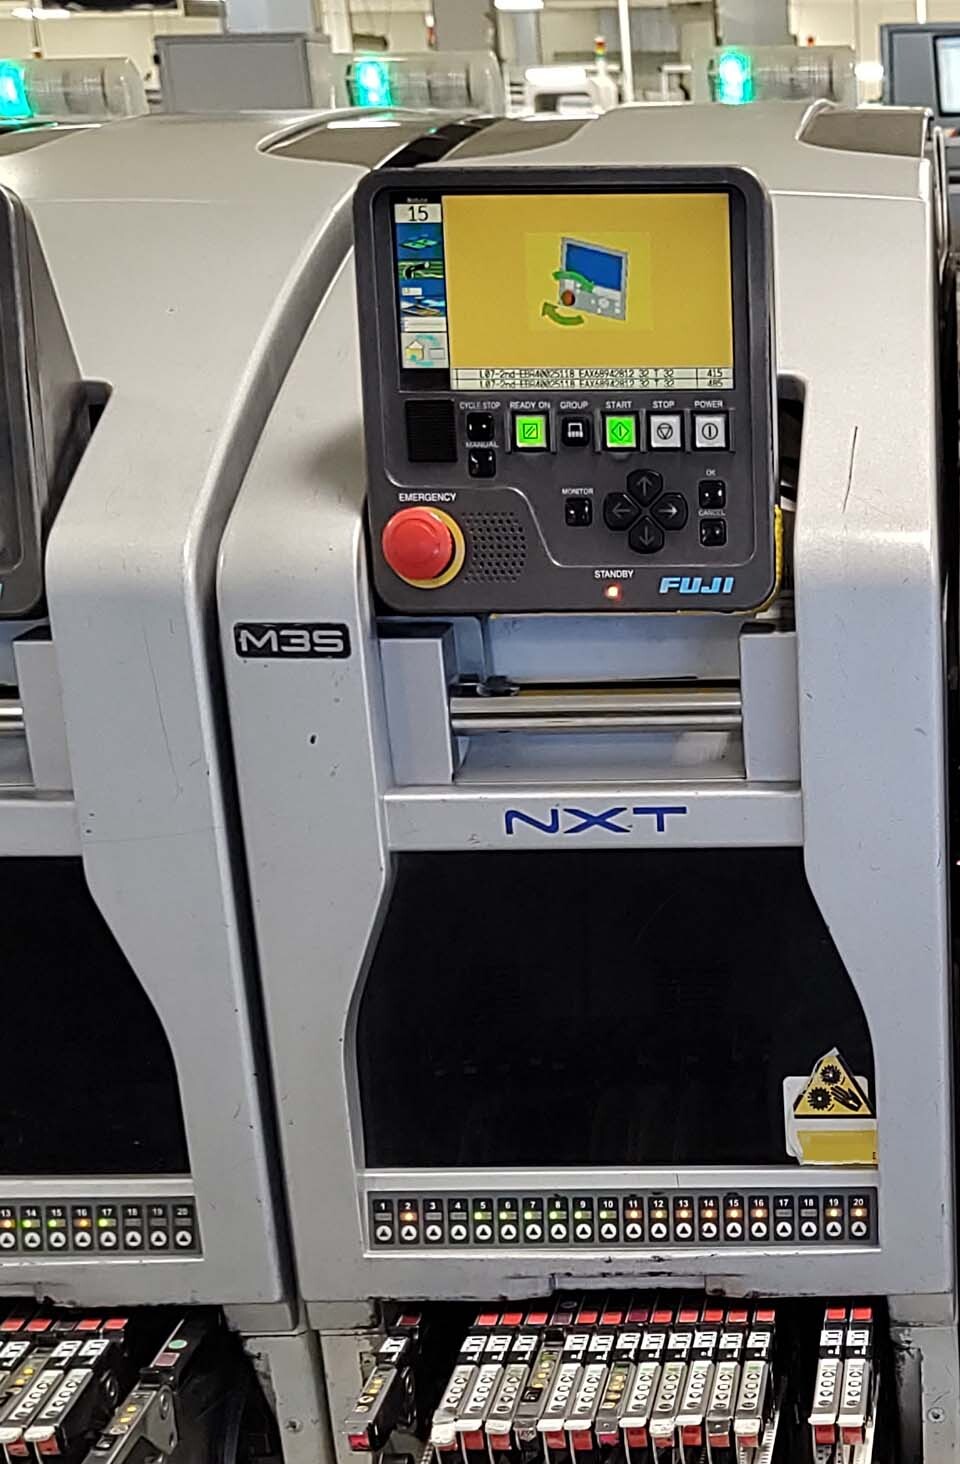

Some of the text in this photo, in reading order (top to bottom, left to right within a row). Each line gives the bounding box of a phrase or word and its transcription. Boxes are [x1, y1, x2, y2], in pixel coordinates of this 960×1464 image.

[407, 205, 429, 222] 15
[509, 401, 551, 409] READY ON
[559, 401, 589, 409] GROUP
[605, 400, 632, 409] START
[652, 400, 675, 409] STOP
[694, 400, 723, 408] POWER
[398, 492, 457, 502] EMERGENCY
[594, 570, 634, 579] STANDBY
[659, 577, 735, 594] FUJI
[239, 629, 344, 652] M3S
[504, 806, 687, 835] NXT
[603, 1200, 614, 1209] 10
[628, 1199, 638, 1208] 11
[653, 1199, 664, 1208] 12
[678, 1199, 689, 1208] 13
[703, 1199, 714, 1207] 14
[729, 1199, 739, 1207] 15
[754, 1199, 764, 1207] 16
[778, 1198, 789, 1207] 17
[804, 1198, 814, 1207] 18
[829, 1198, 839, 1207] 19
[853, 1198, 864, 1206] 20
[0, 1209, 11, 1217] 13
[25, 1209, 37, 1217] 14
[51, 1208, 62, 1217] 15
[76, 1208, 88, 1217] 16
[101, 1208, 113, 1216] 17
